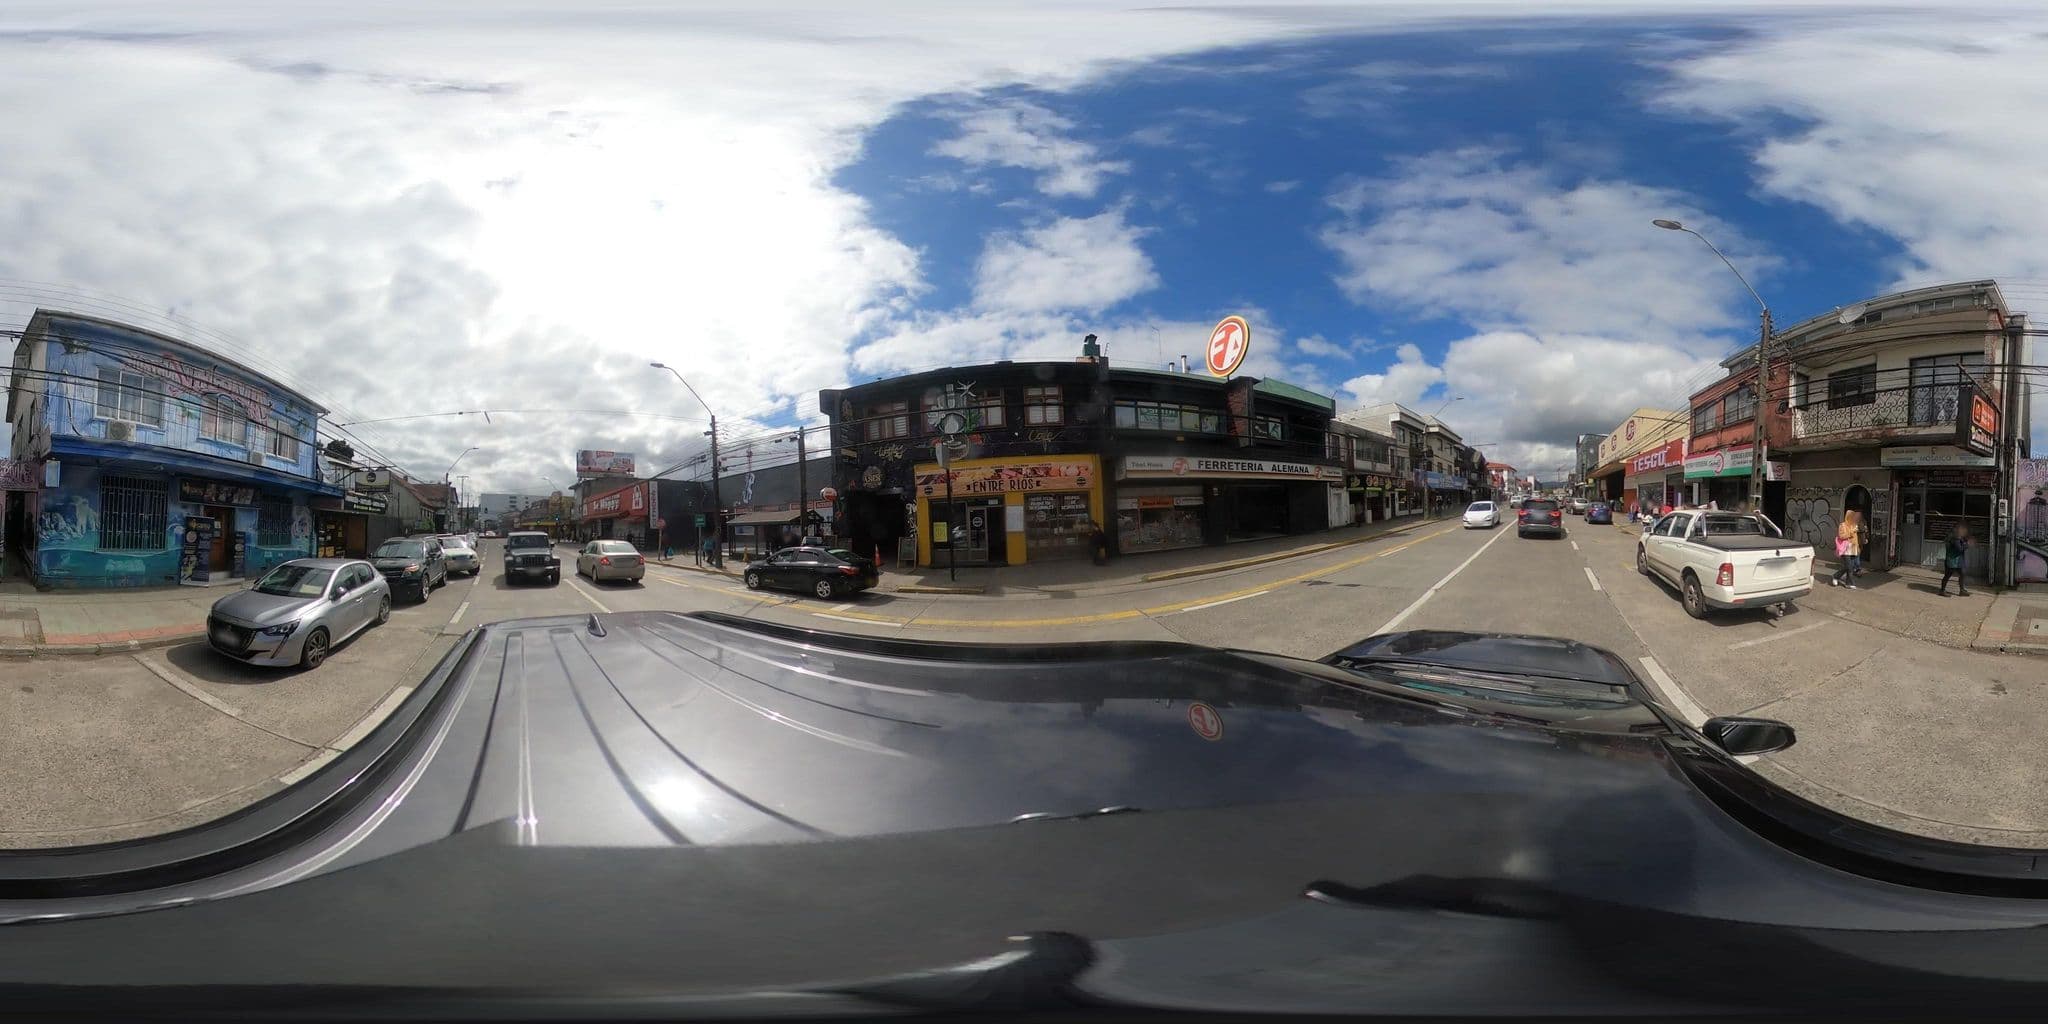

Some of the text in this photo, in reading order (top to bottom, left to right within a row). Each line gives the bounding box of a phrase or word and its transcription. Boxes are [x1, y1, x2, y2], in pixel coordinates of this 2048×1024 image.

[1198, 460, 1309, 473] FERRETERIA ALEMANA
[1633, 451, 1665, 472] TESCO
[973, 479, 1034, 493] ENTRE RIOS
